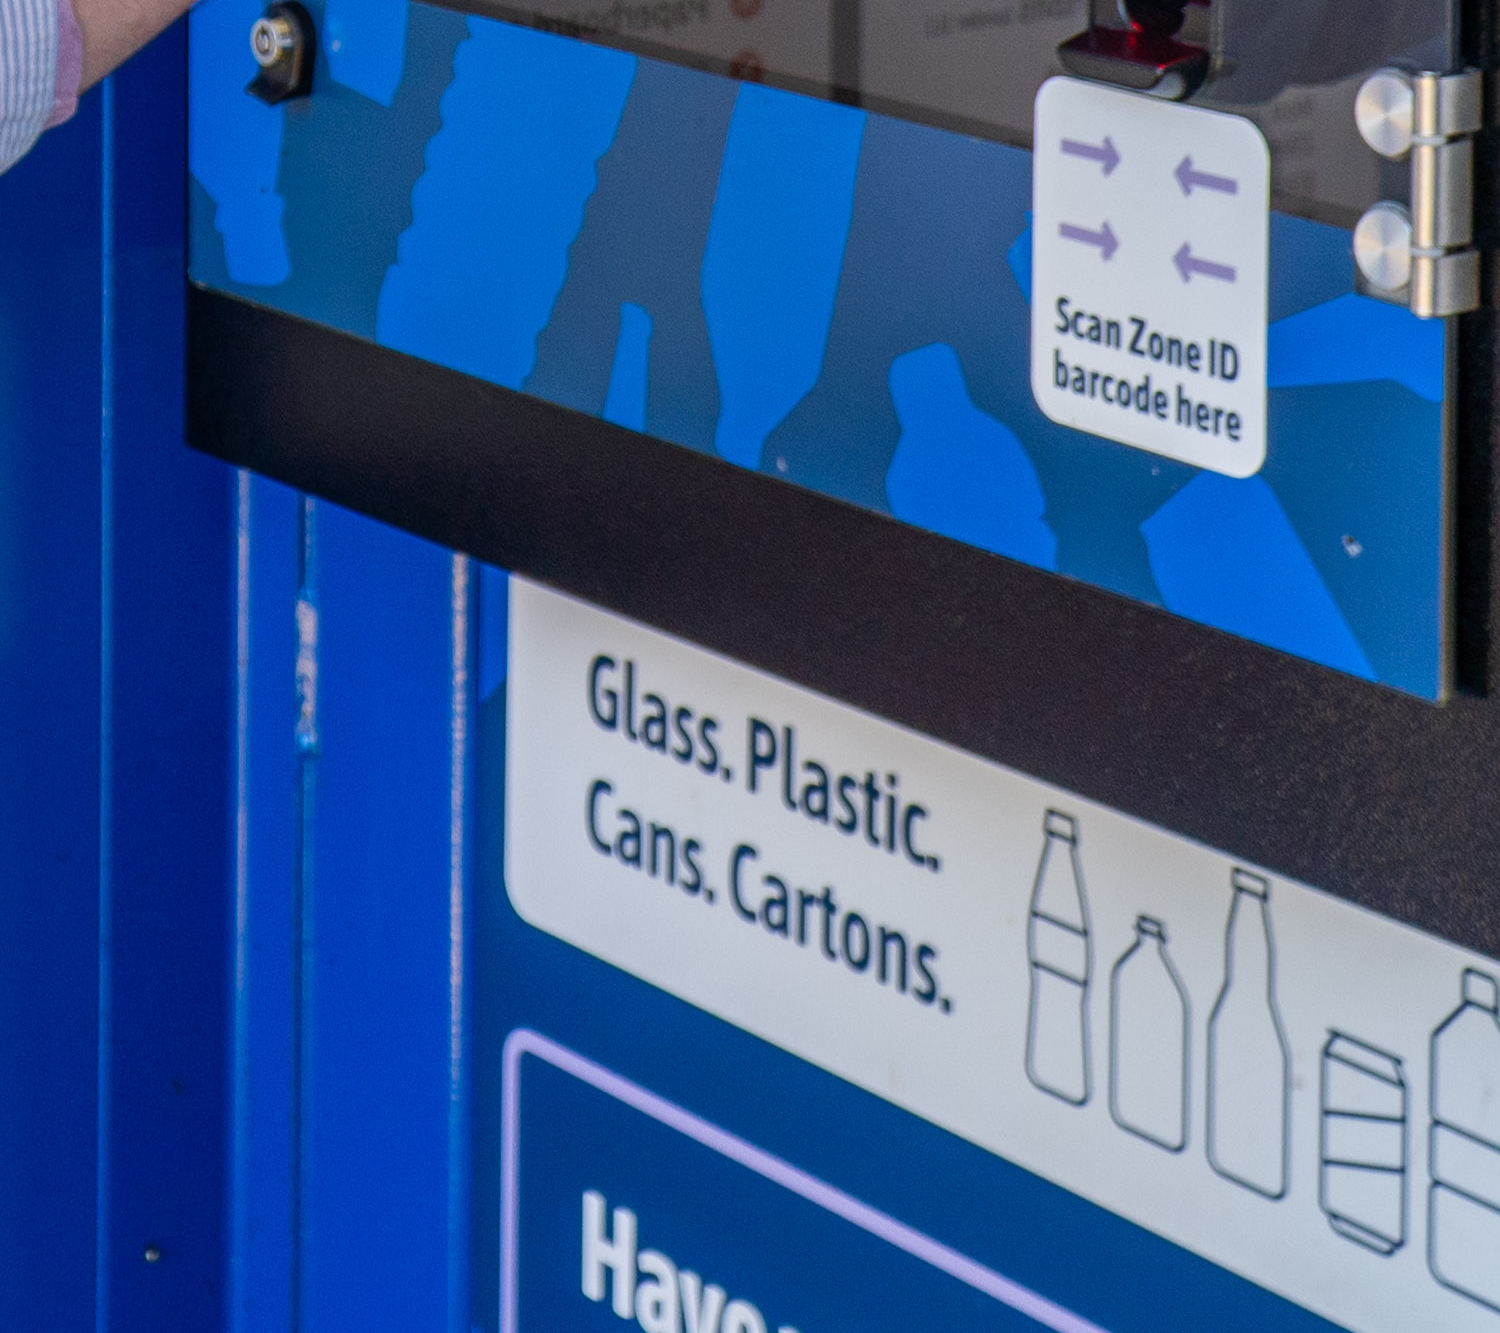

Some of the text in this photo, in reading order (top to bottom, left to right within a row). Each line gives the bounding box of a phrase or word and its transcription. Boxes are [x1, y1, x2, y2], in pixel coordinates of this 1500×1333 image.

[1054, 348, 1242, 442] barcode here
[1055, 296, 1240, 382] Scan Zone ID
[588, 653, 940, 872] Glass. Plastic.
[586, 778, 953, 1015] Cans. Cartons.
